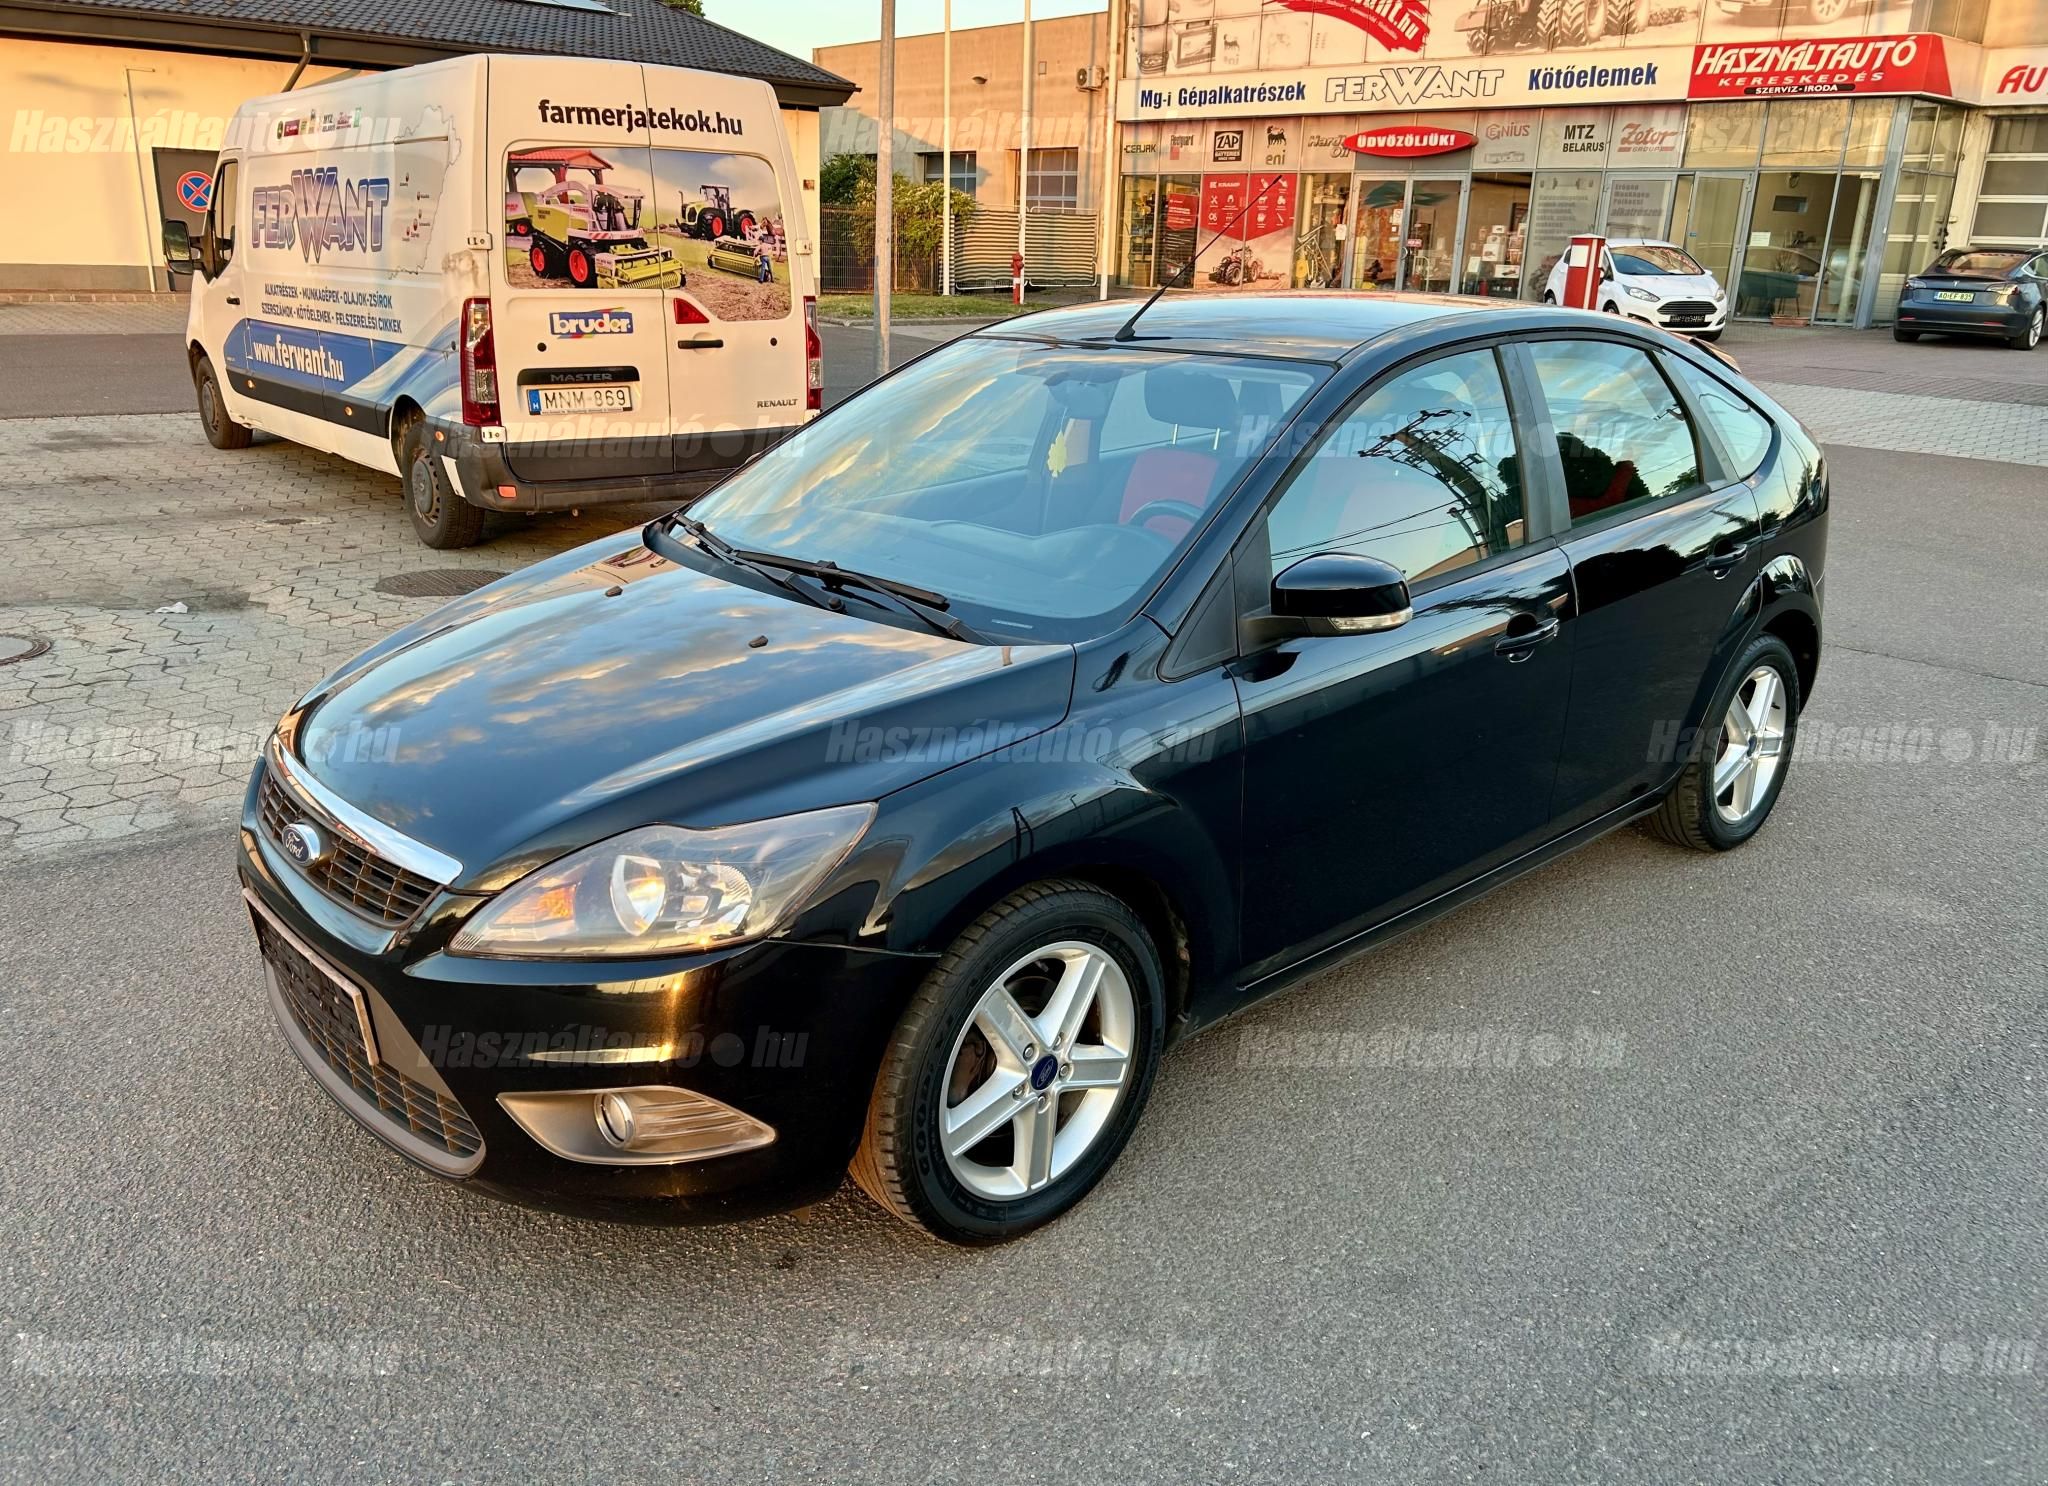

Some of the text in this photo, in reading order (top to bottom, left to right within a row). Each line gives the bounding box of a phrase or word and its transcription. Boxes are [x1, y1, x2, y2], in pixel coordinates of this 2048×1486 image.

[1695, 35, 1917, 75] HASZNÁLTAUTÓ
[1528, 62, 1658, 91] Kötőelemek
[1718, 72, 1884, 87] KERESKEDÉS
[1996, 65, 2048, 95] AU
[1140, 81, 1306, 109] Mg-i Gépalkatrészek
[538, 99, 743, 135] farmerjatekok.hu
[1216, 134, 1239, 148] ZAP
[1308, 135, 1346, 148] Hard
[1357, 133, 1456, 148] ÜDVÖZÖLJÜK!
[1564, 125, 1595, 140] MTZ
[1620, 122, 1679, 146] Zetor
[1562, 141, 1605, 153] BELARUS
[1265, 150, 1285, 166] eni
[265, 282, 298, 299] ALKATRÉSZEK
[303, 286, 339, 304] MUNKAGÉPEK
[262, 302, 294, 318] SZERSZÁMOK
[336, 312, 378, 330] FELSZERELÉSI
[378, 318, 402, 333] CIKKEK
[552, 313, 630, 333] bruder
[253, 334, 345, 382] www.ferwant.hu
[550, 373, 613, 382] MASTER
[544, 389, 626, 409] MNM-869
[757, 398, 798, 408] RENAULT
[285, 830, 304, 858] Ford
